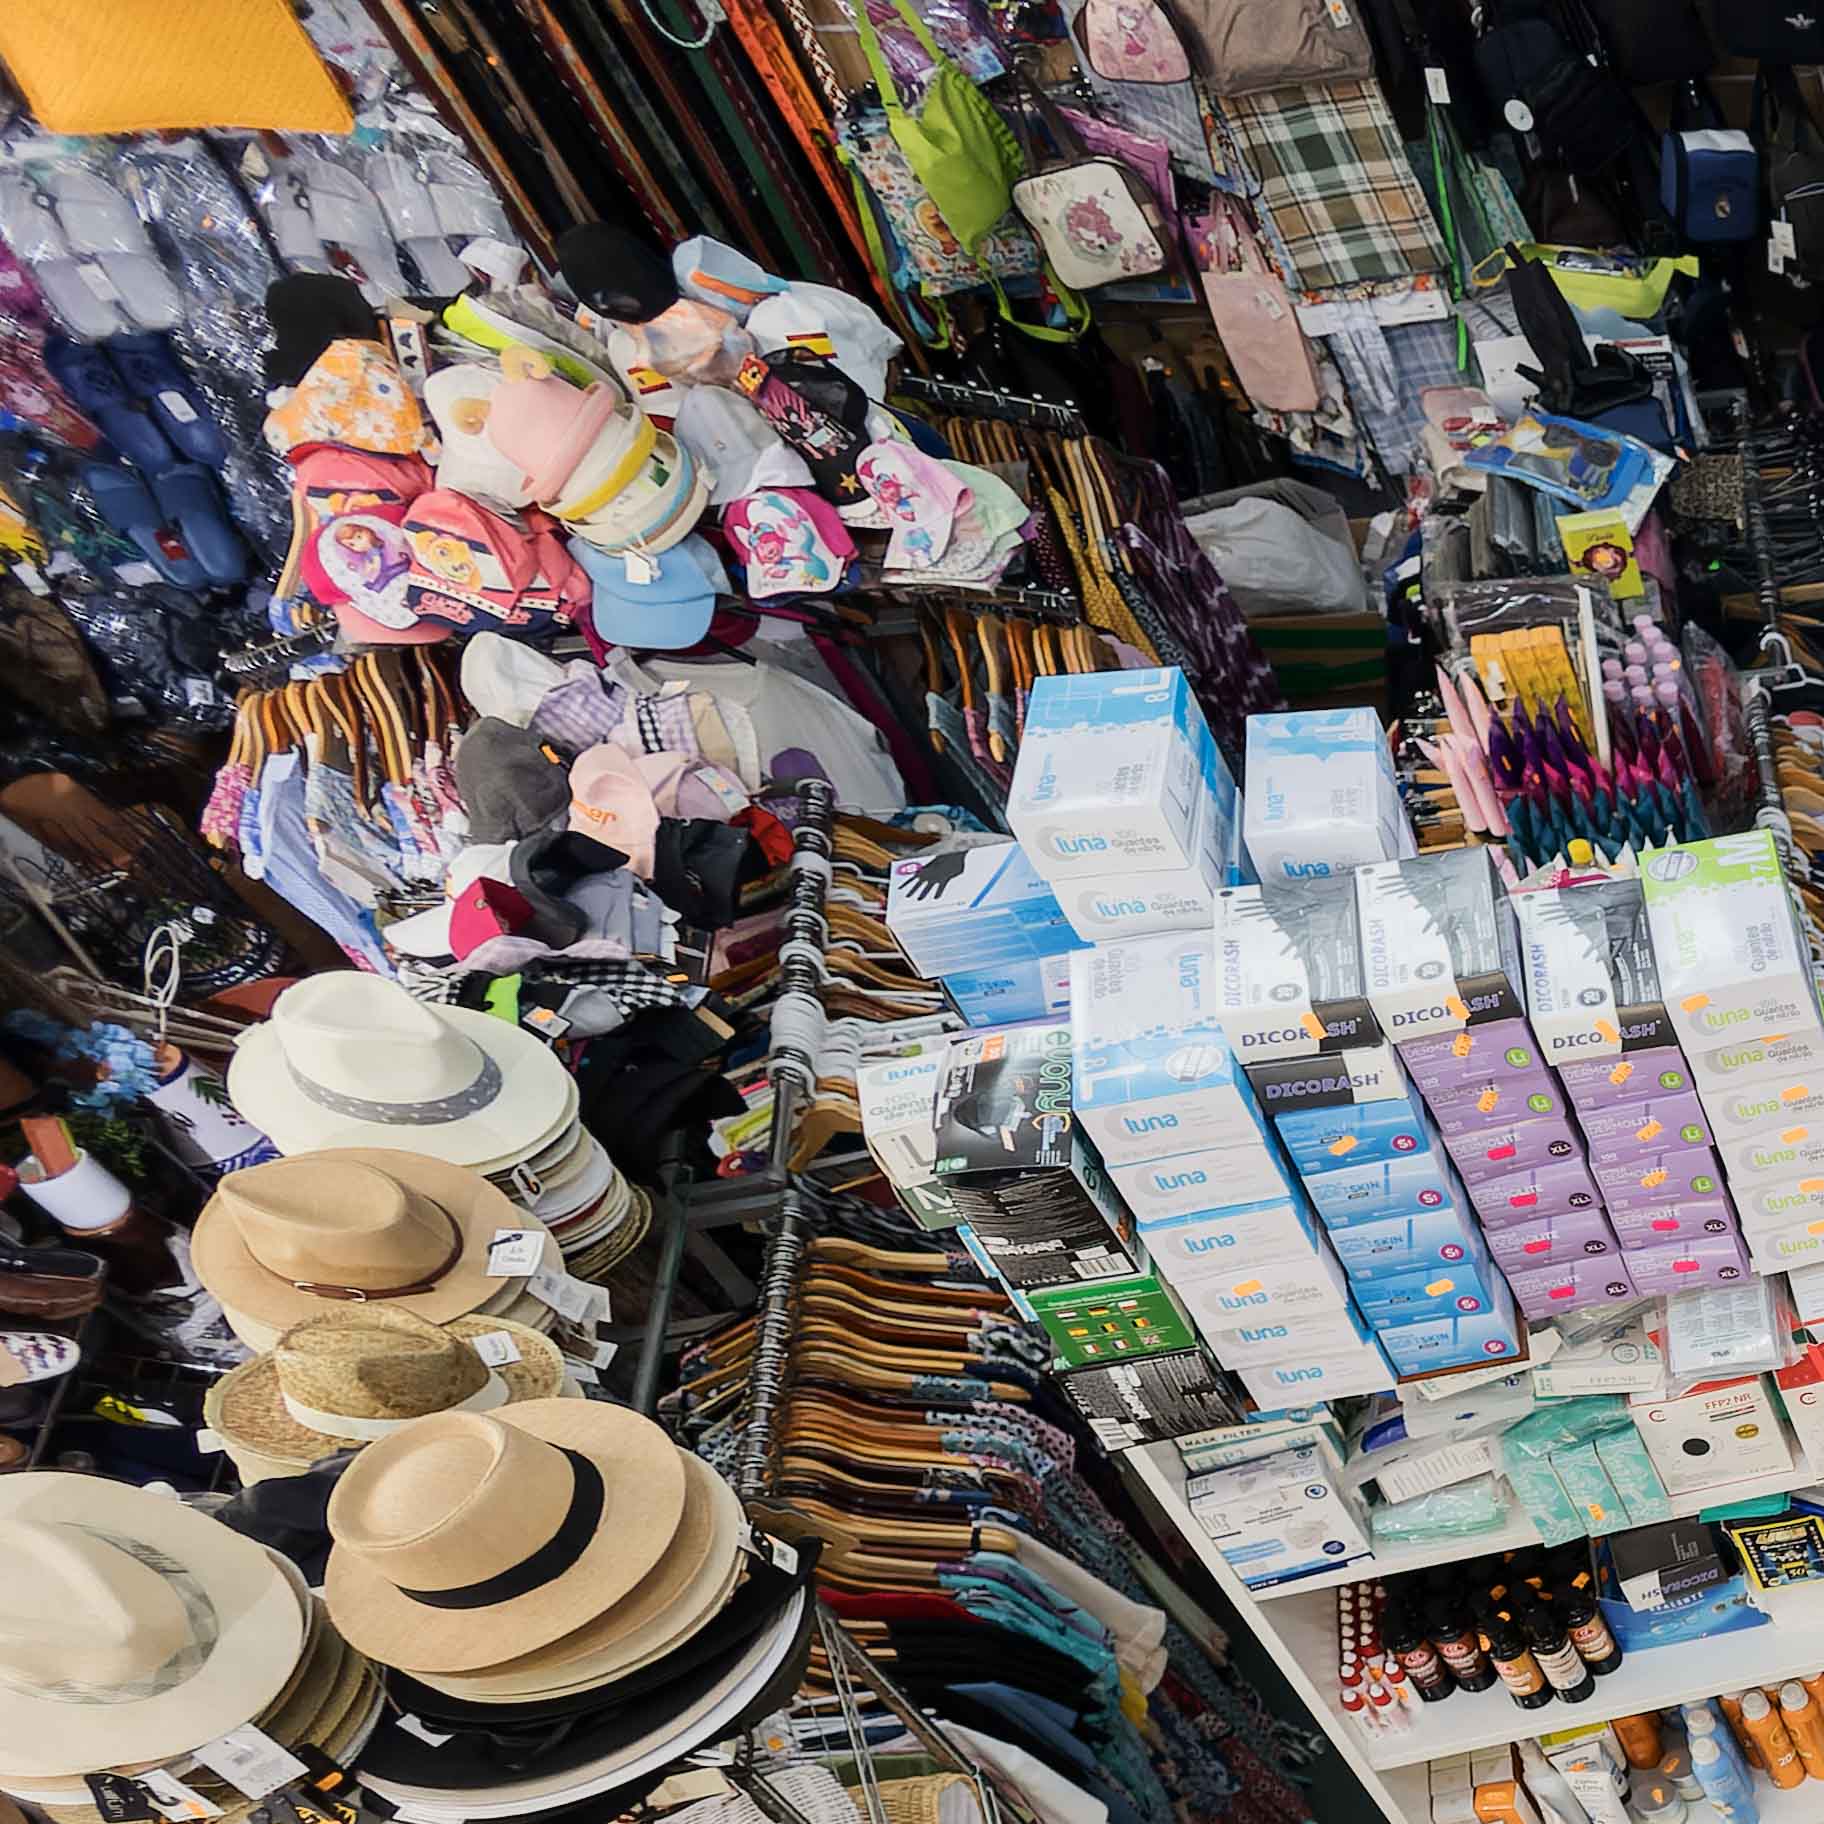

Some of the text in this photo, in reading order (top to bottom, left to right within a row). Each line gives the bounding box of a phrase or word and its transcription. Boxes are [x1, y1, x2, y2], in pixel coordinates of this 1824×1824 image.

[1055, 827, 1107, 853] luna
[1283, 860, 1331, 878] luna
[1096, 893, 1146, 917] luna
[1368, 917, 1389, 988] DICORASH
[1223, 939, 1241, 1008] DICORASH
[1529, 944, 1553, 1013] DICORASH
[1704, 1007, 1750, 1028] luna
[1753, 1002, 1797, 1018] Guantes
[1721, 1048, 1764, 1067] luna
[1767, 1043, 1809, 1058] Guantes
[888, 1061, 936, 1082] luna
[1264, 1071, 1382, 1100] DICORASH
[1737, 1100, 1780, 1118] luna
[1123, 1110, 1178, 1135] luna
[1753, 1149, 1796, 1167] luna
[1154, 1167, 1207, 1191] luna
[1767, 1193, 1807, 1211] luna
[1184, 1230, 1236, 1254] luna
[1778, 1237, 1819, 1256] luna
[1219, 1286, 1268, 1310] luna
[1239, 1323, 1288, 1346] luna
[1275, 1365, 1324, 1388] luna
[1703, 1392, 1753, 1410] FFP2 NR
[1184, 1427, 1262, 1448] MASK FILTER
